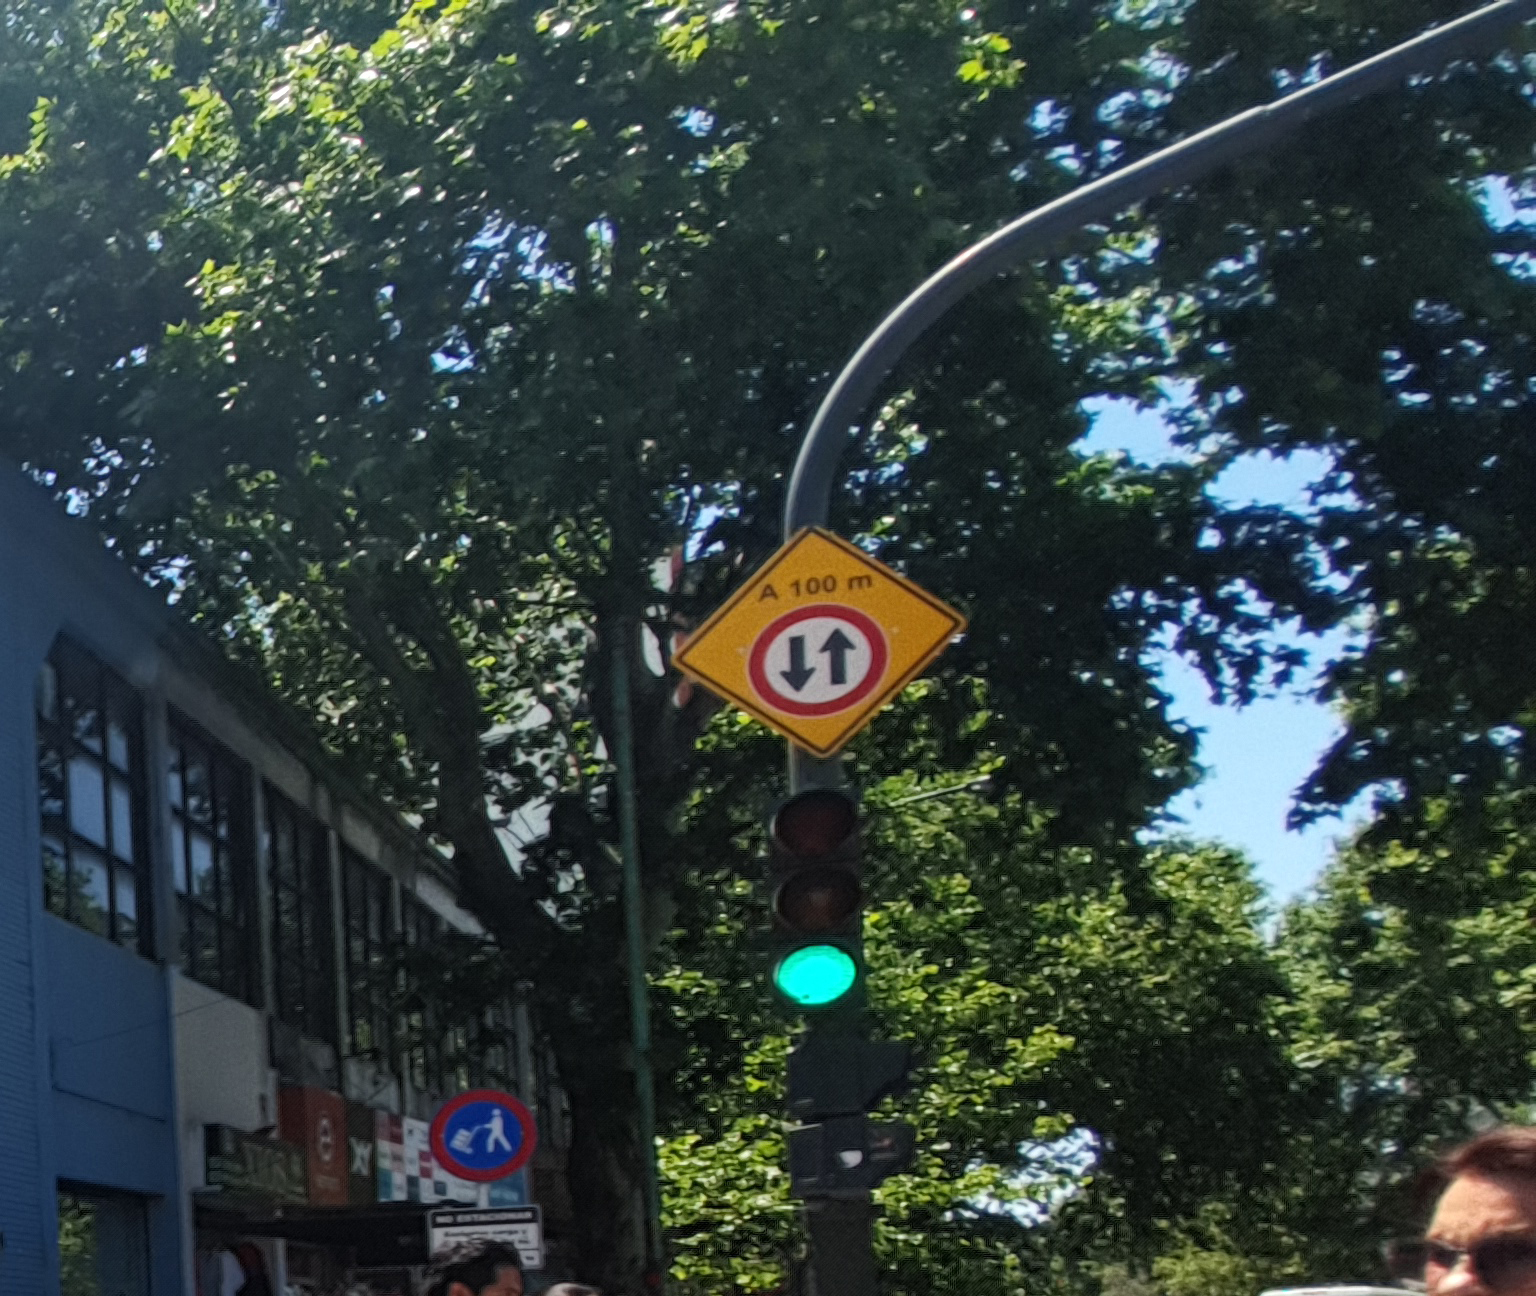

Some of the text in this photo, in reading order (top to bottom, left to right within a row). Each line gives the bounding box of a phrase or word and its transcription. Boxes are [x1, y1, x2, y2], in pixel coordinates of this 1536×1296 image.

[759, 574, 873, 602] A 100 m
